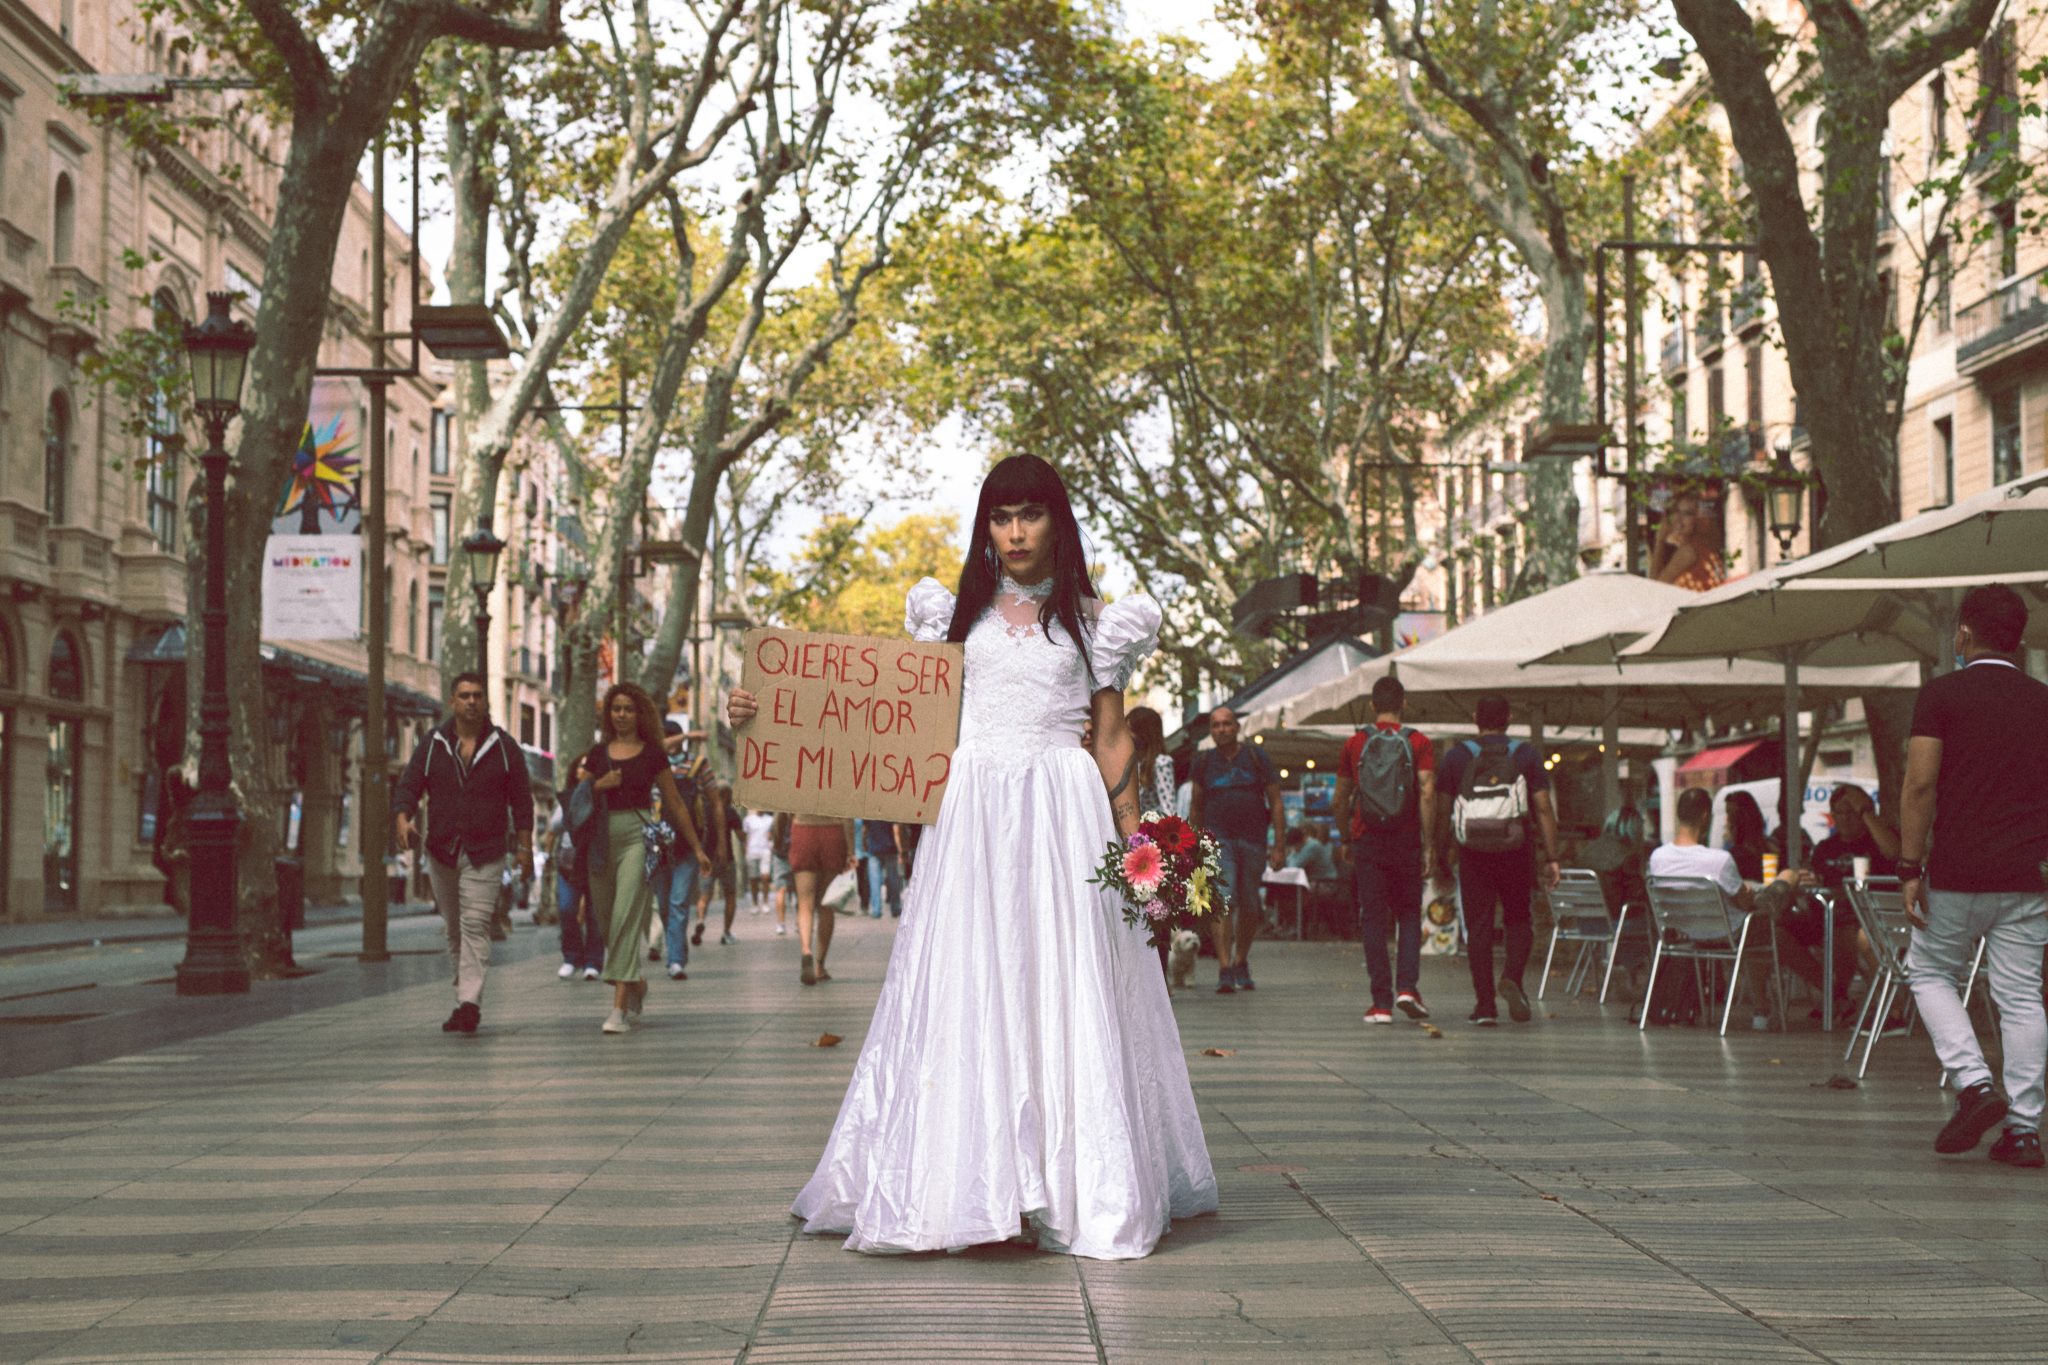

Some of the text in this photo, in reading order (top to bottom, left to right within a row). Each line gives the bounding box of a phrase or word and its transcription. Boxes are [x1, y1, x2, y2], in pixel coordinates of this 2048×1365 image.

[757, 637, 950, 697] QIERES SER
[773, 688, 916, 735] EL AMOR
[741, 737, 950, 817] DE MI VISA?
